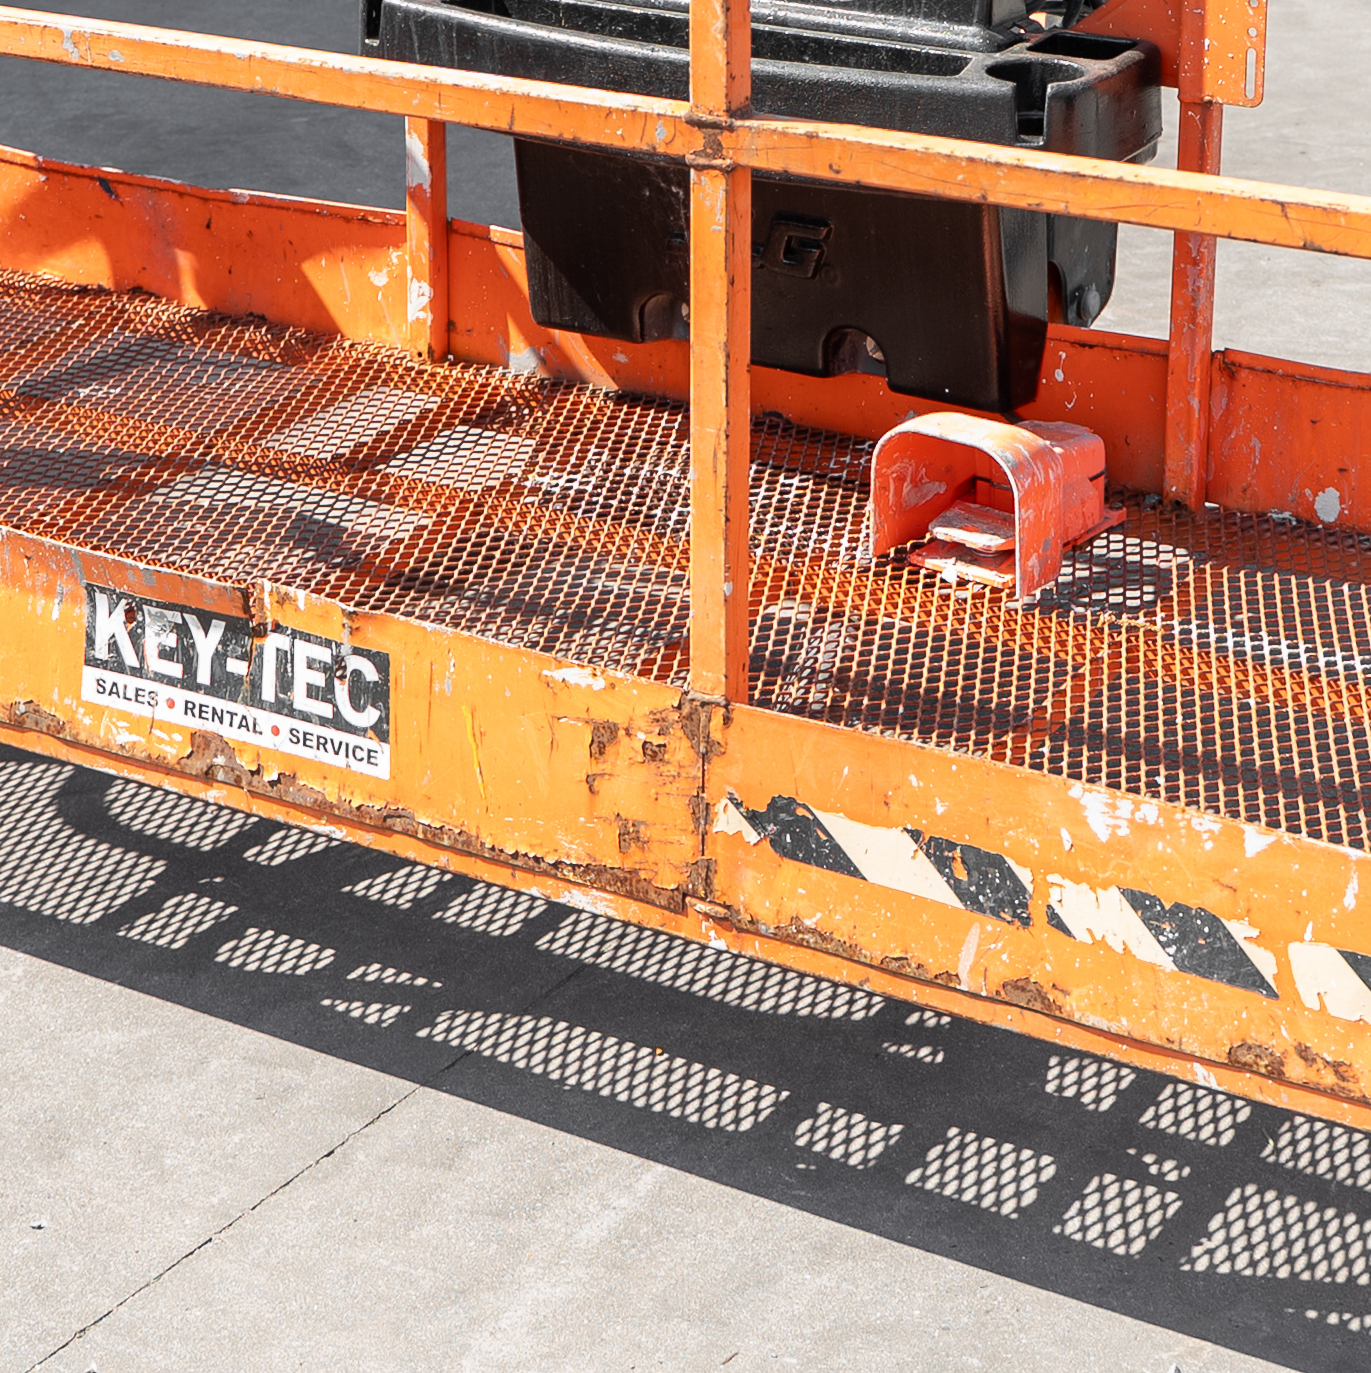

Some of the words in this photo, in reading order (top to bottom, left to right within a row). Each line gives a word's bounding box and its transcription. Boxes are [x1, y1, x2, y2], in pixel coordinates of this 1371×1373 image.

[94, 592, 381, 728] KEY-TEC
[96, 678, 159, 708] SALES
[184, 699, 263, 736] RENTAL
[288, 728, 379, 767] SERVICE
